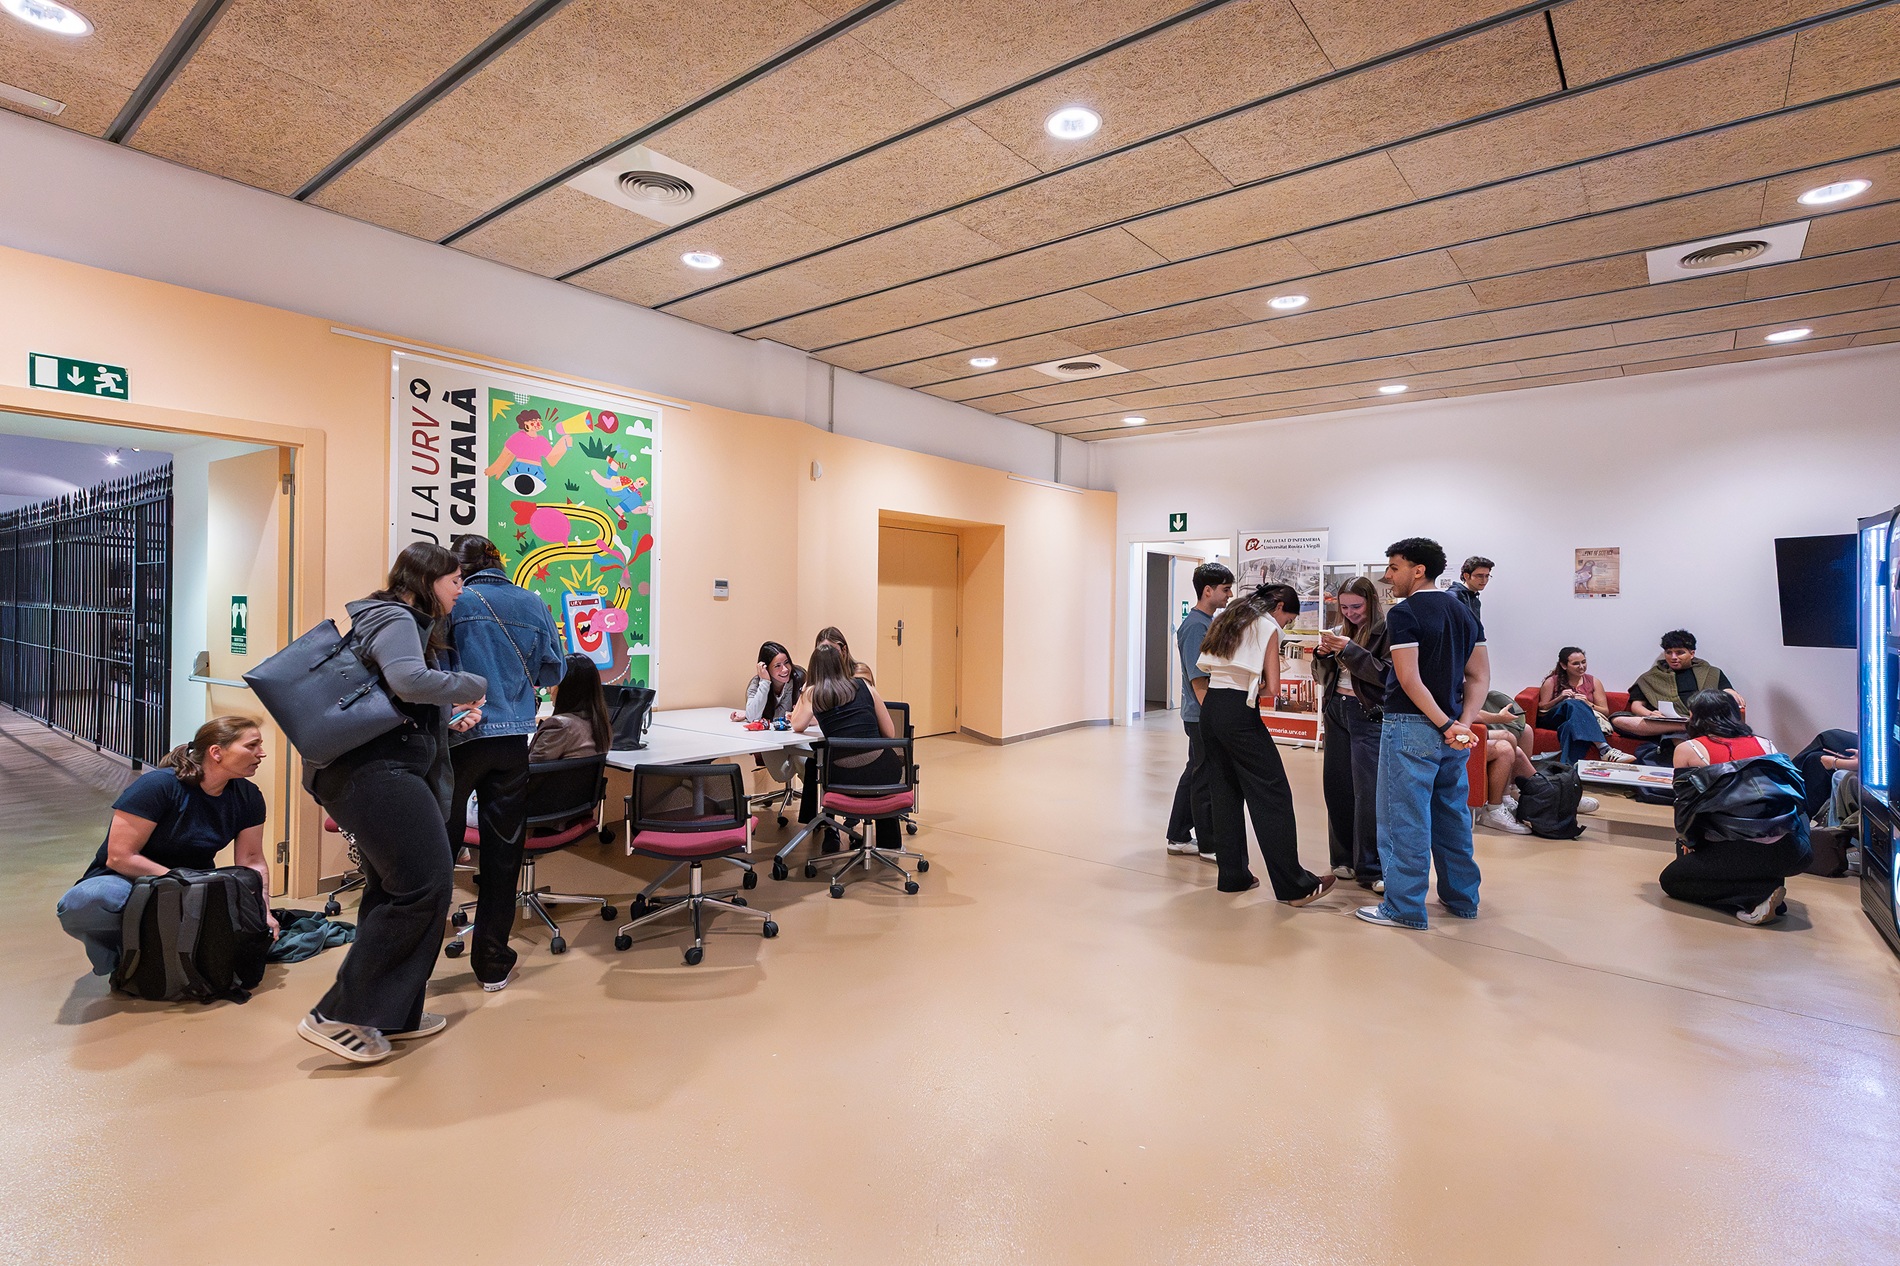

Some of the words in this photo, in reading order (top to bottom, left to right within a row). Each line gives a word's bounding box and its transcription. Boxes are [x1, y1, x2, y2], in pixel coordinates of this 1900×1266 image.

[412, 406, 440, 476] URV
[442, 388, 477, 526] CATALÀ
[411, 486, 439, 523] LA
